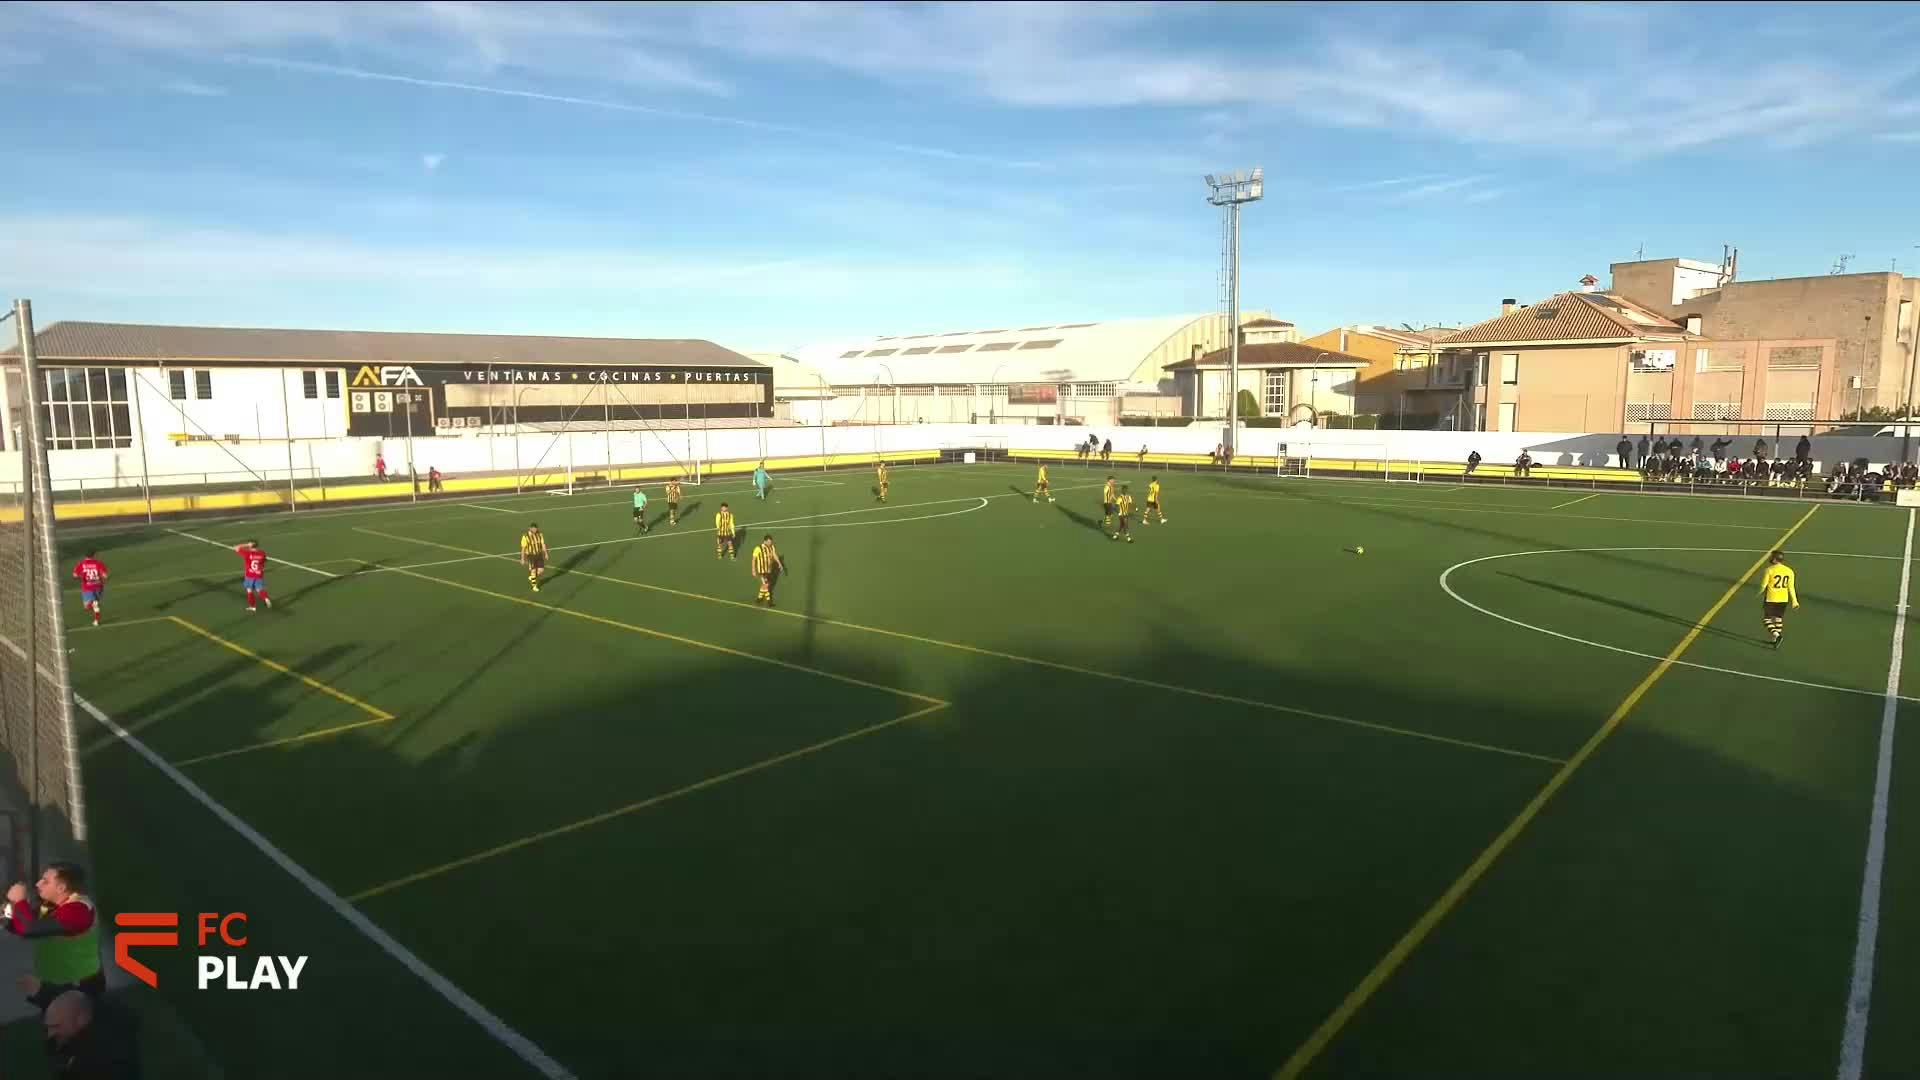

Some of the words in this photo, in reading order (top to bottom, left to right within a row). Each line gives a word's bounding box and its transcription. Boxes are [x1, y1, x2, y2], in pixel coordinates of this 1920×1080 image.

[463, 371, 561, 381] VENTANAS
[588, 371, 662, 381] COCINAS
[685, 372, 749, 382] PUERTAS
[250, 559, 259, 571] 6
[1773, 574, 1789, 589] 20
